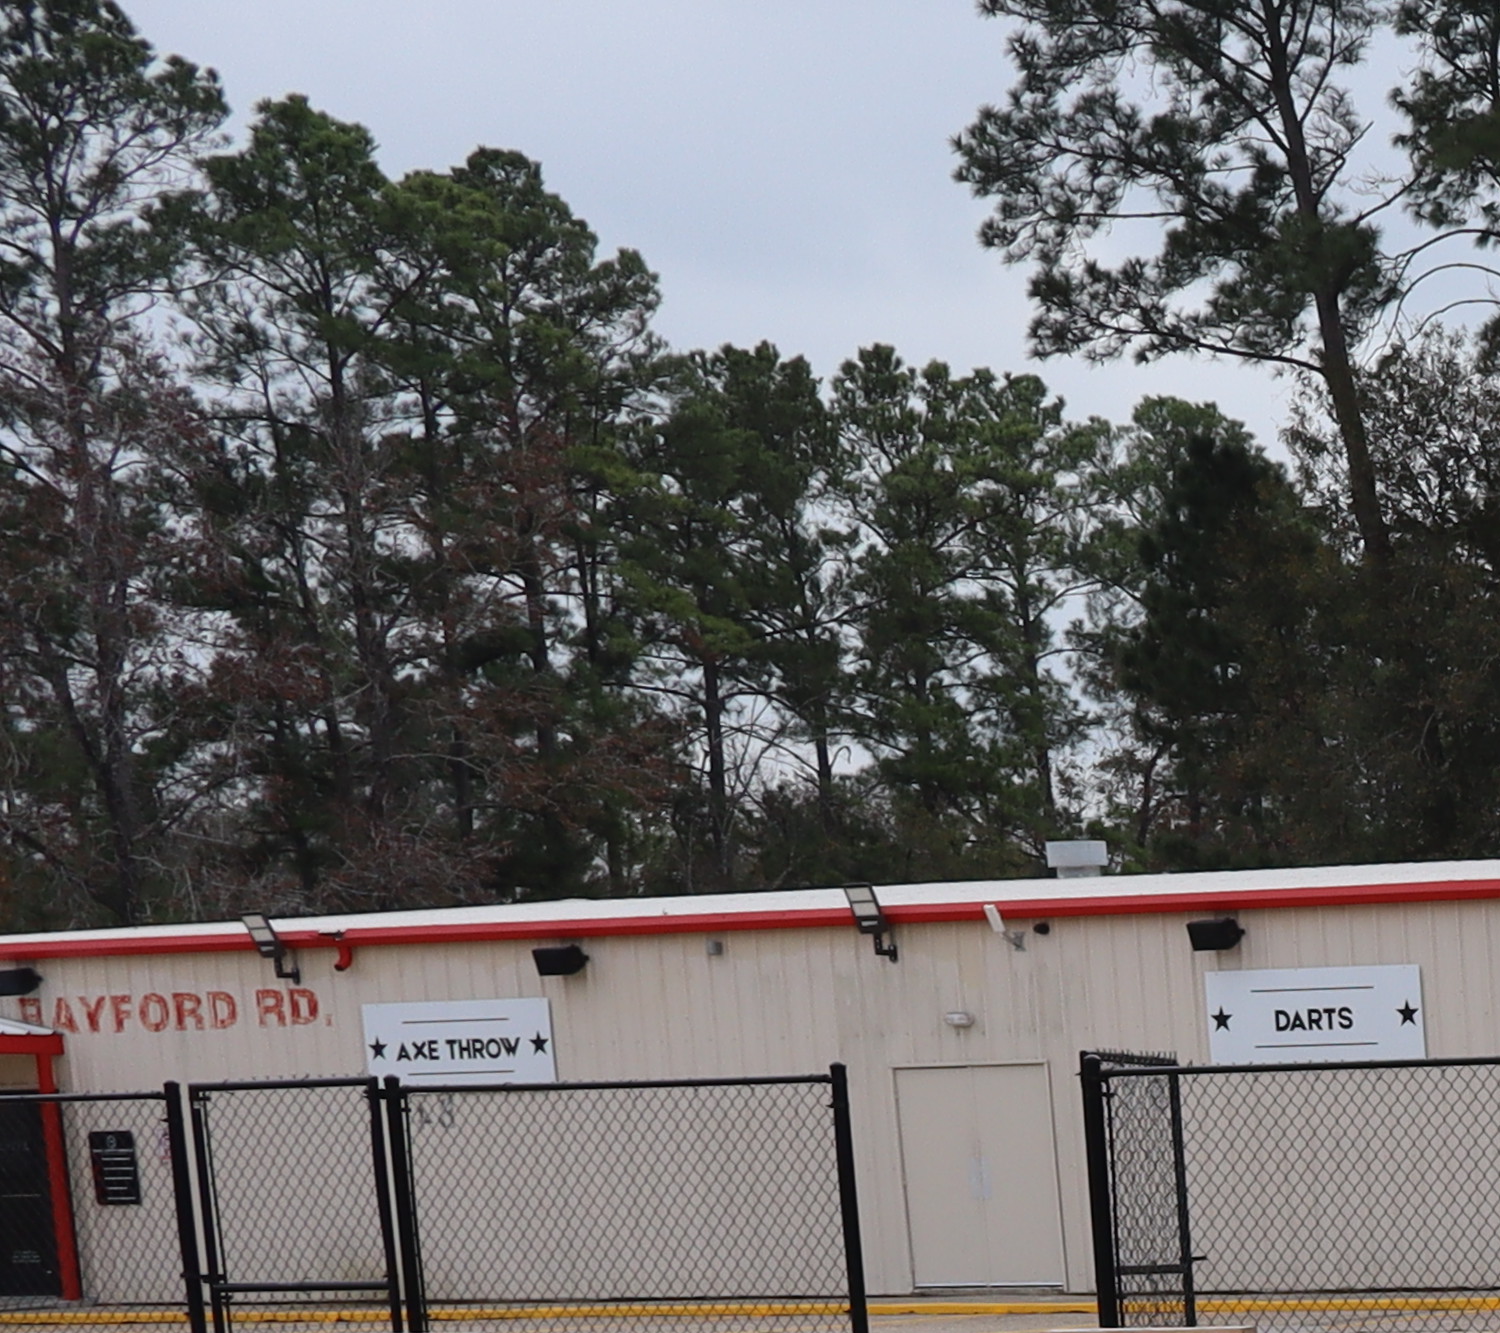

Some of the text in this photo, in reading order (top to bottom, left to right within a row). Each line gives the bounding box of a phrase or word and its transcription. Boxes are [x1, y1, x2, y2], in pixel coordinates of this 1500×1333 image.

[254, 987, 334, 1028] RD.
[1274, 1006, 1354, 1032] DARTS
[396, 1036, 521, 1062] AXE THROW
